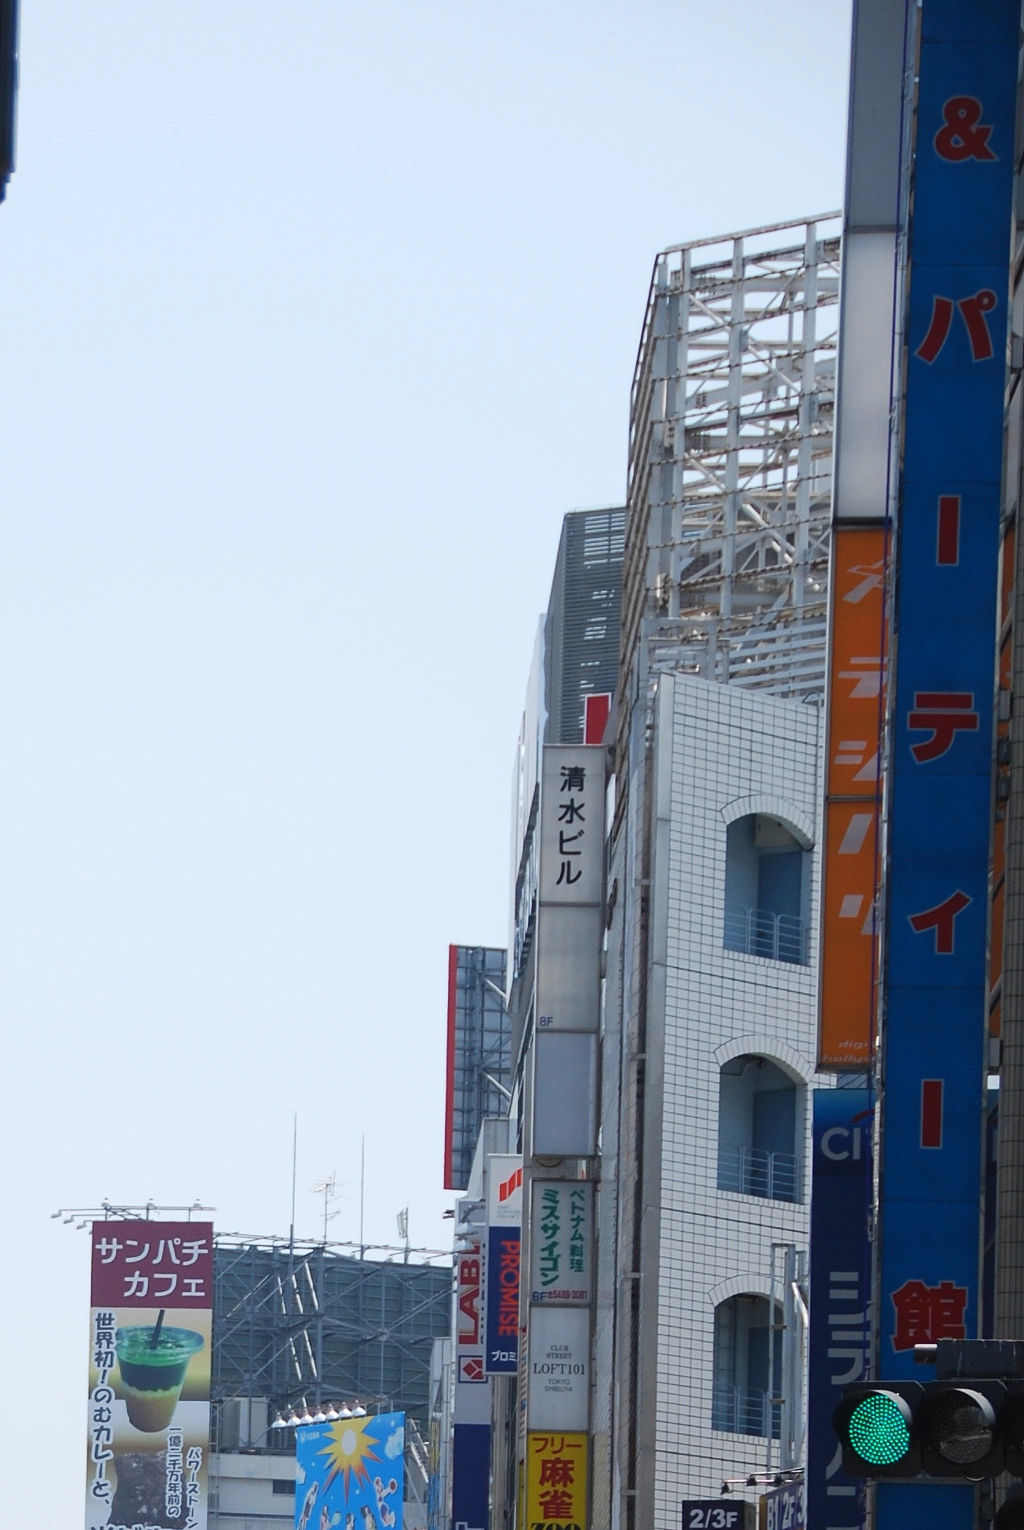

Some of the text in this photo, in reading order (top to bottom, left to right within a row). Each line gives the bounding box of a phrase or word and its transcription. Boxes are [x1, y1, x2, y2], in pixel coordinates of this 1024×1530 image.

[935, 95, 999, 161] &
[556, 765, 586, 886] 清水ビル
[540, 1017, 553, 1027] 8F
[540, 1188, 560, 1287] ミス・サイゴン
[569, 1189, 585, 1272] ベトナム料理
[95, 1238, 208, 1266] サンパチ
[124, 1271, 205, 1297] カフェ
[499, 1240, 520, 1337] PROMISE
[492, 1350, 519, 1362] プロミ
[533, 1363, 585, 1375] LOFT101
[532, 1436, 582, 1454] フリー
[539, 1457, 575, 1520] 麻雀
[689, 1508, 738, 1530] 2/3F
